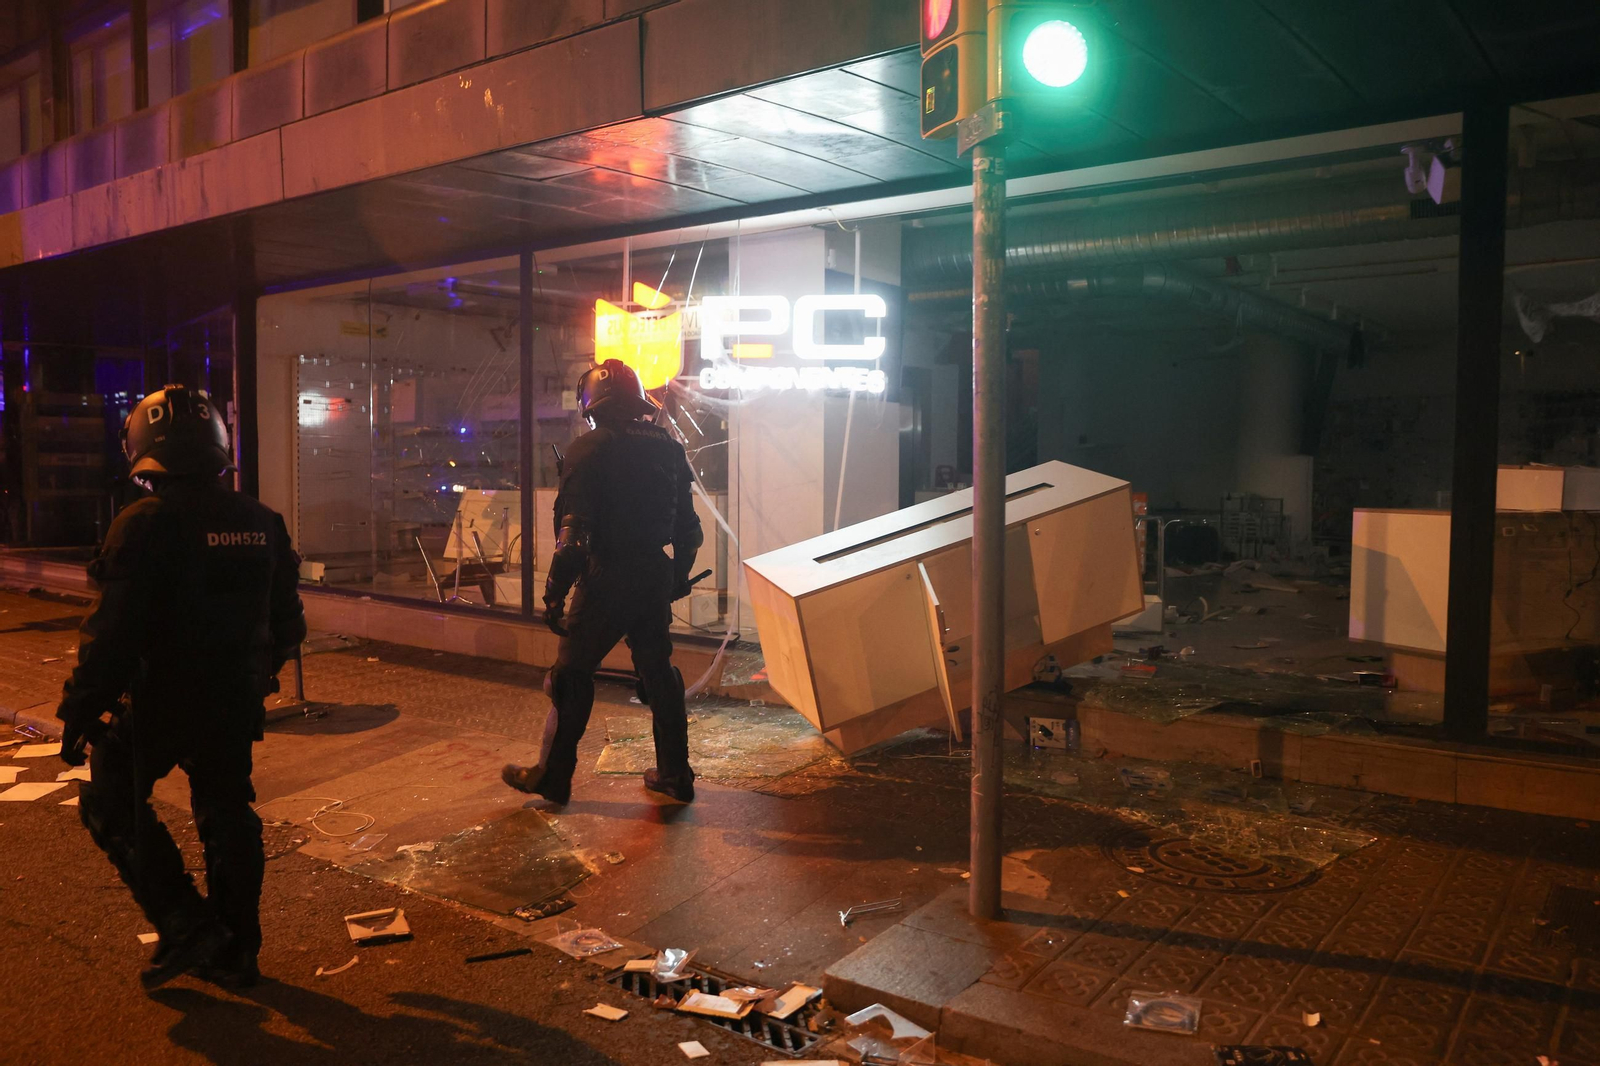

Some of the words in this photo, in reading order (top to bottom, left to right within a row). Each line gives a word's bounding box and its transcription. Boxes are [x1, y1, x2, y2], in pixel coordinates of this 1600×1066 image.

[700, 294, 886, 360] PC
[598, 369, 609, 381] D
[147, 405, 164, 424] D
[198, 403, 210, 420] 3
